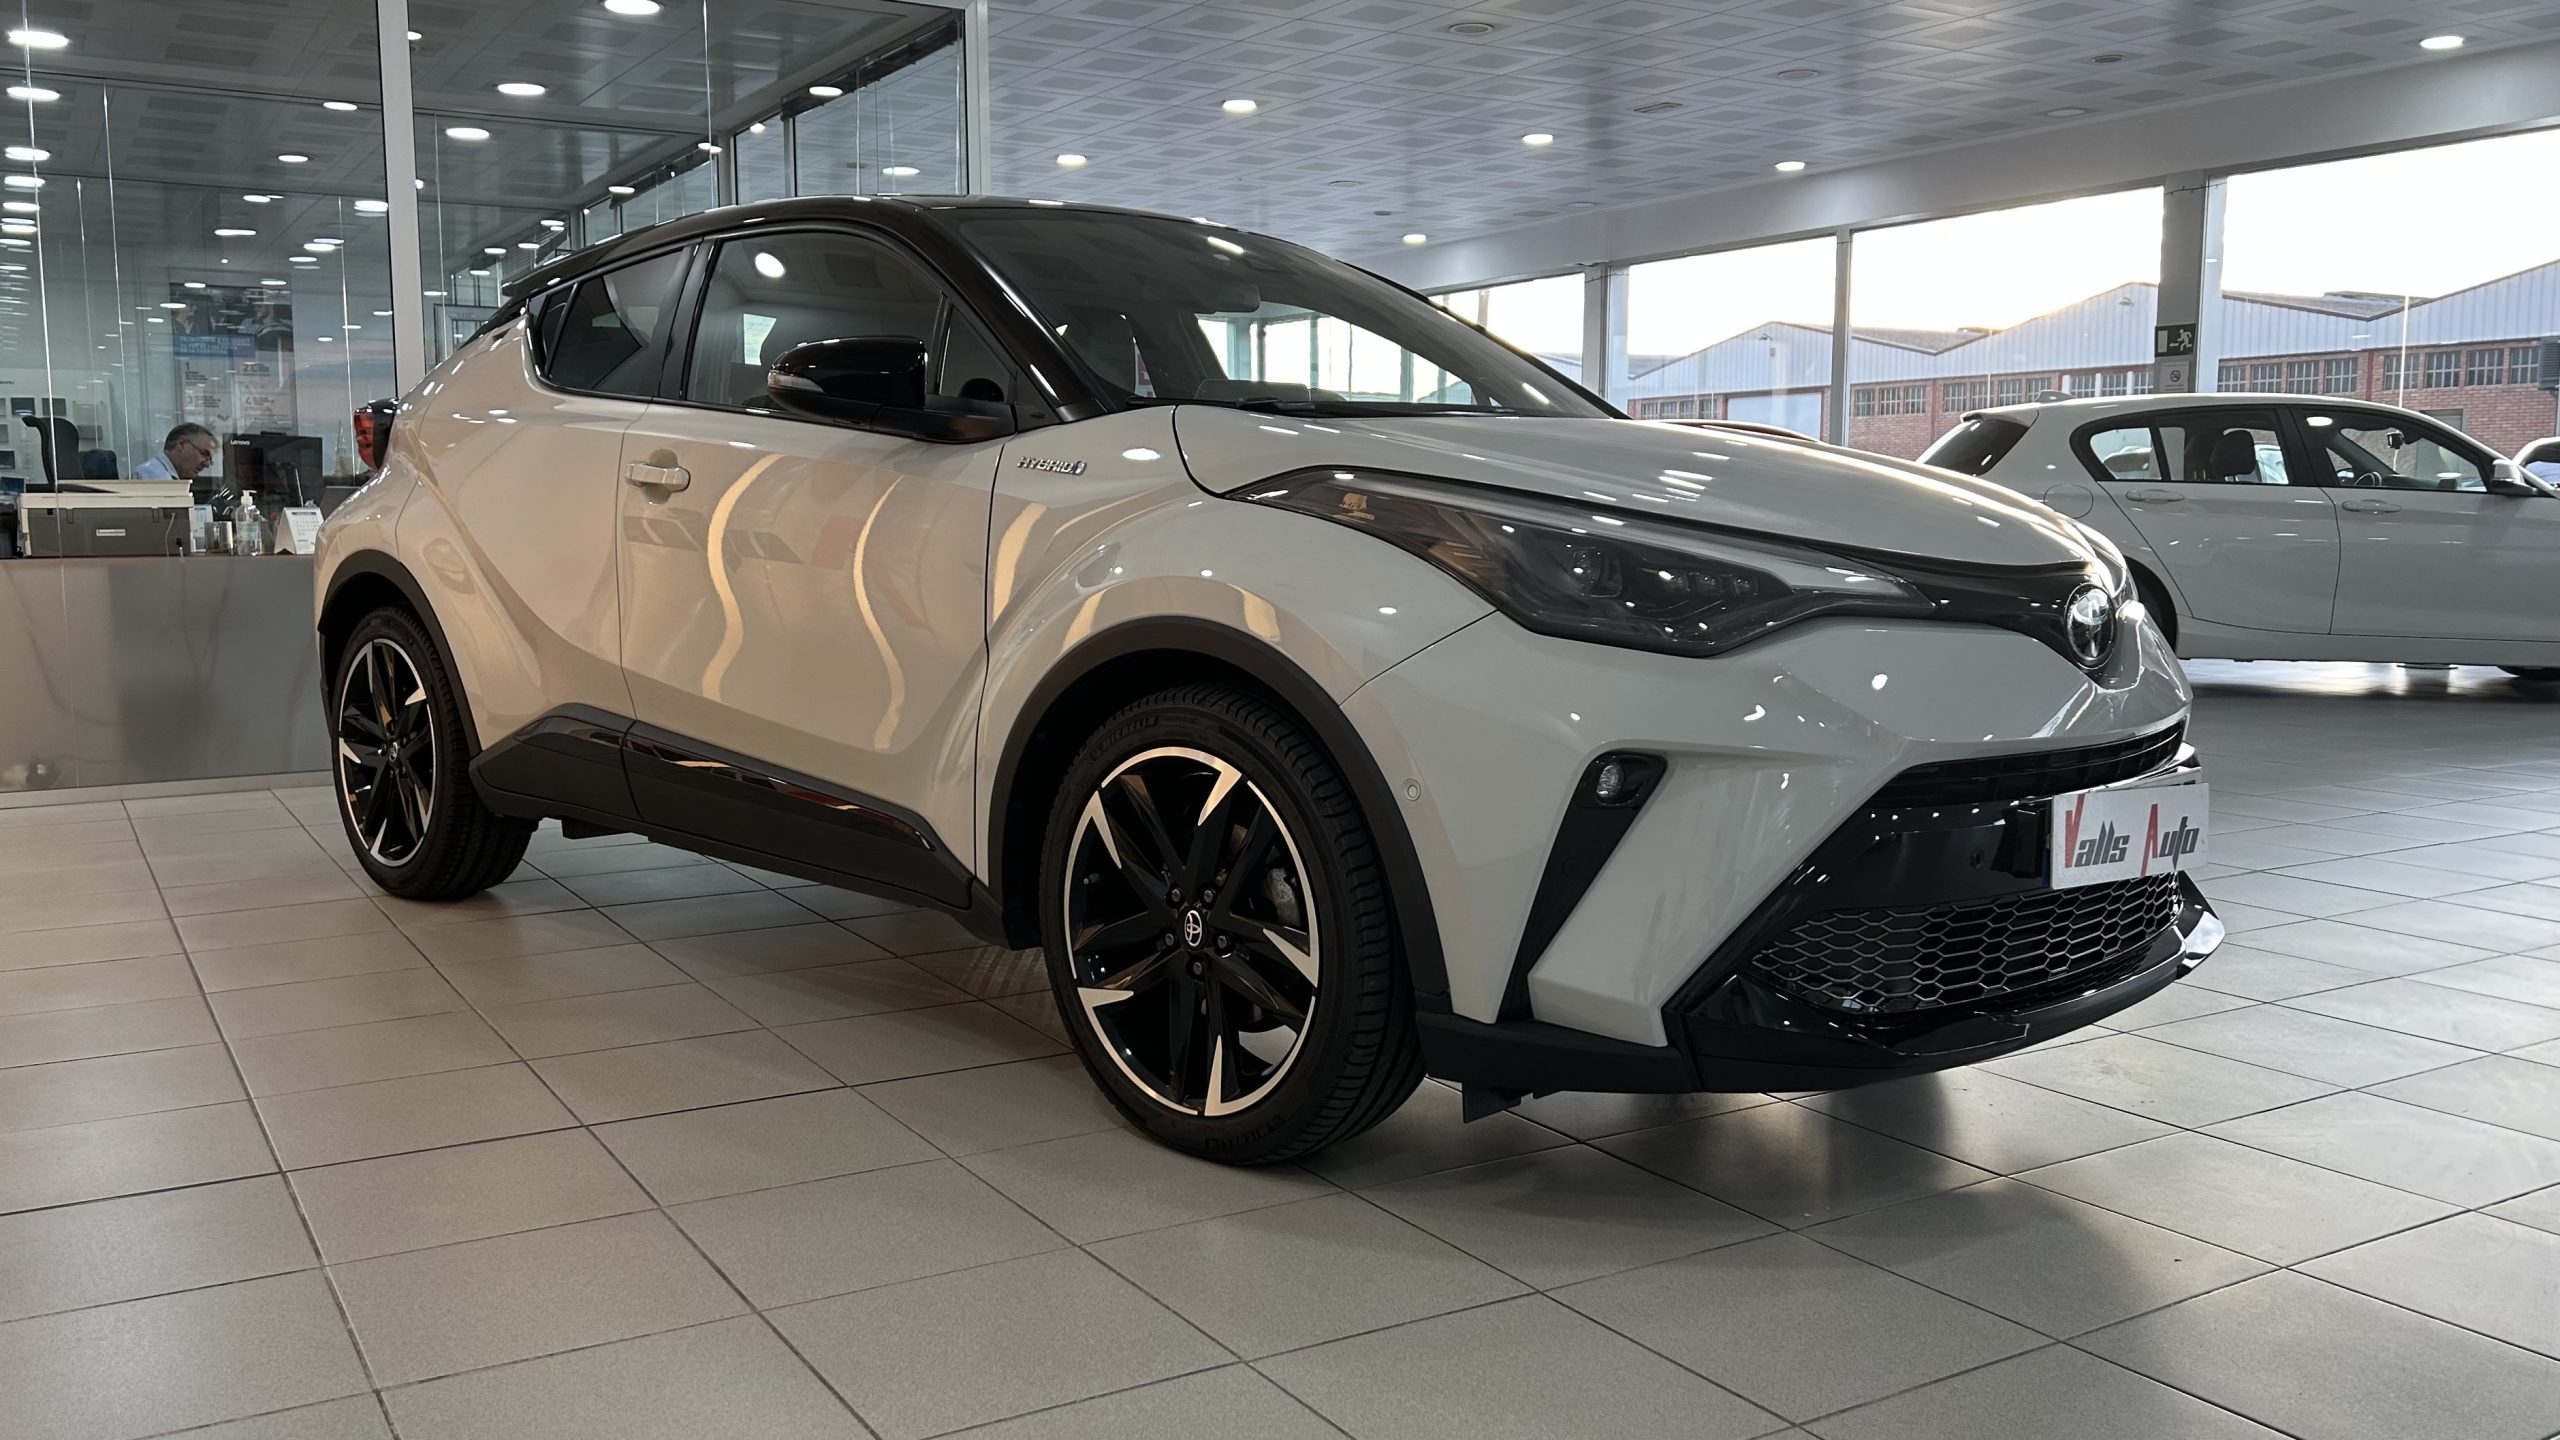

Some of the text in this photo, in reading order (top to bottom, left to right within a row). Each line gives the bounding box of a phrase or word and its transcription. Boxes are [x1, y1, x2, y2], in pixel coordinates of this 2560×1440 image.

[1016, 456, 1075, 474] HYBRID
[2065, 793, 2200, 877] Valls Auto
